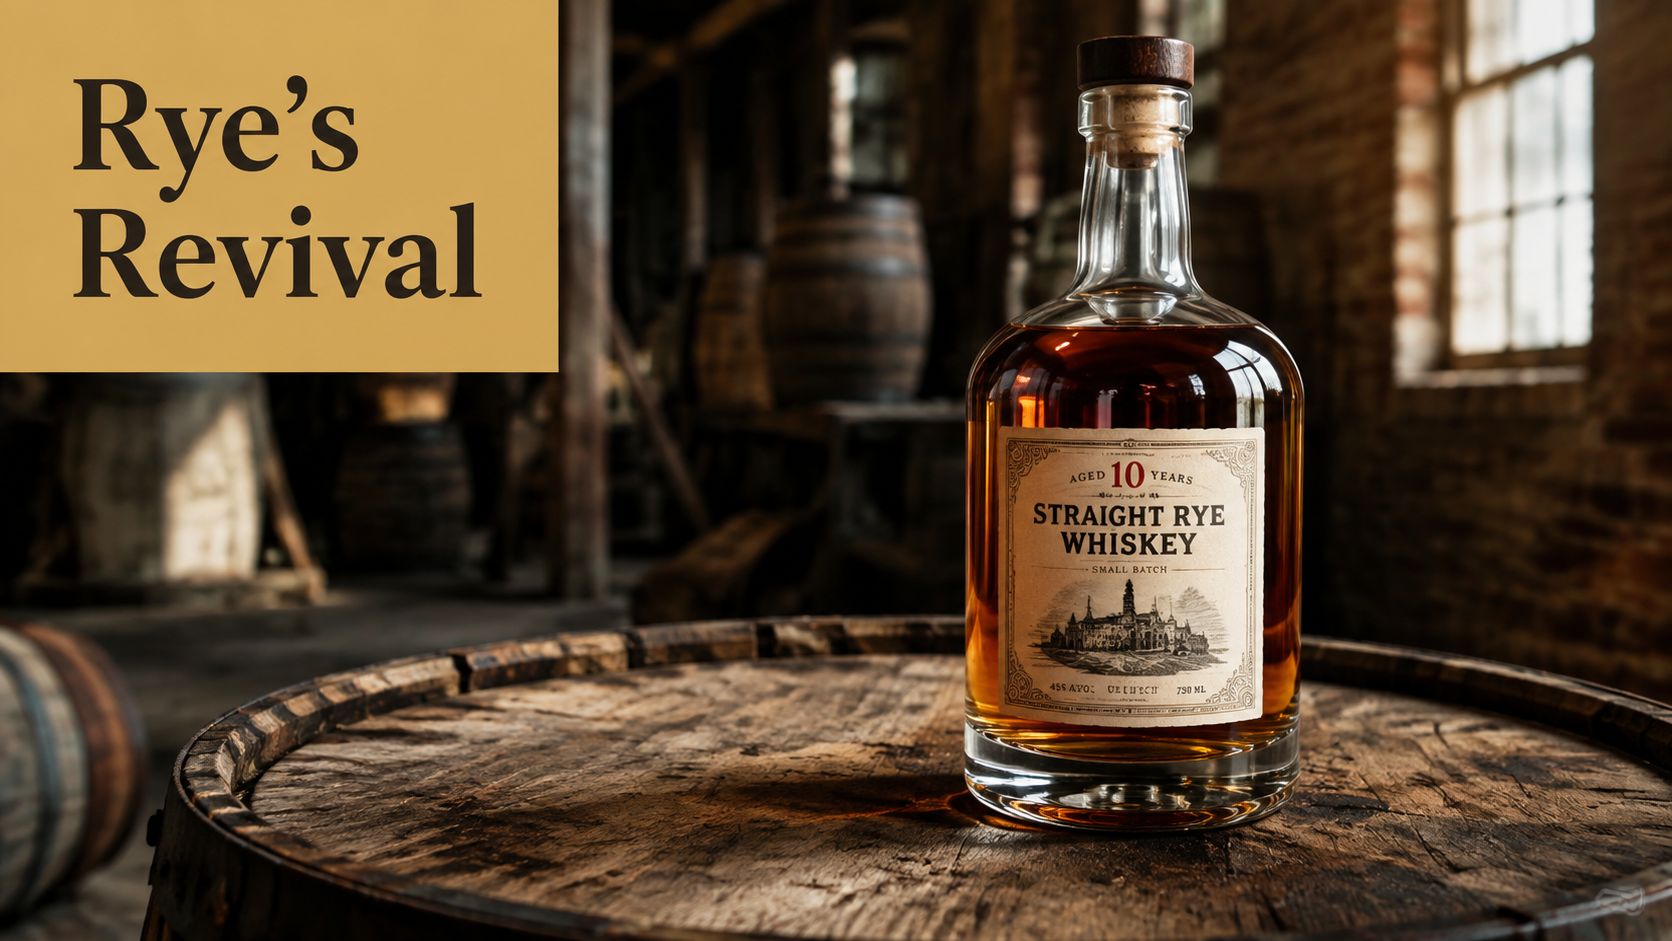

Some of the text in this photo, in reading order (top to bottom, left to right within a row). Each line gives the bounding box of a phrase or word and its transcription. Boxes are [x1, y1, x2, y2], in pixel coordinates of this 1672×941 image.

[1069, 460, 1194, 489] AGED 10 YEARS
[1033, 502, 1226, 527] STRAIGHT RYE
[1060, 531, 1198, 556] WHISKEY
[1091, 565, 1168, 574] SMALL BATCH
